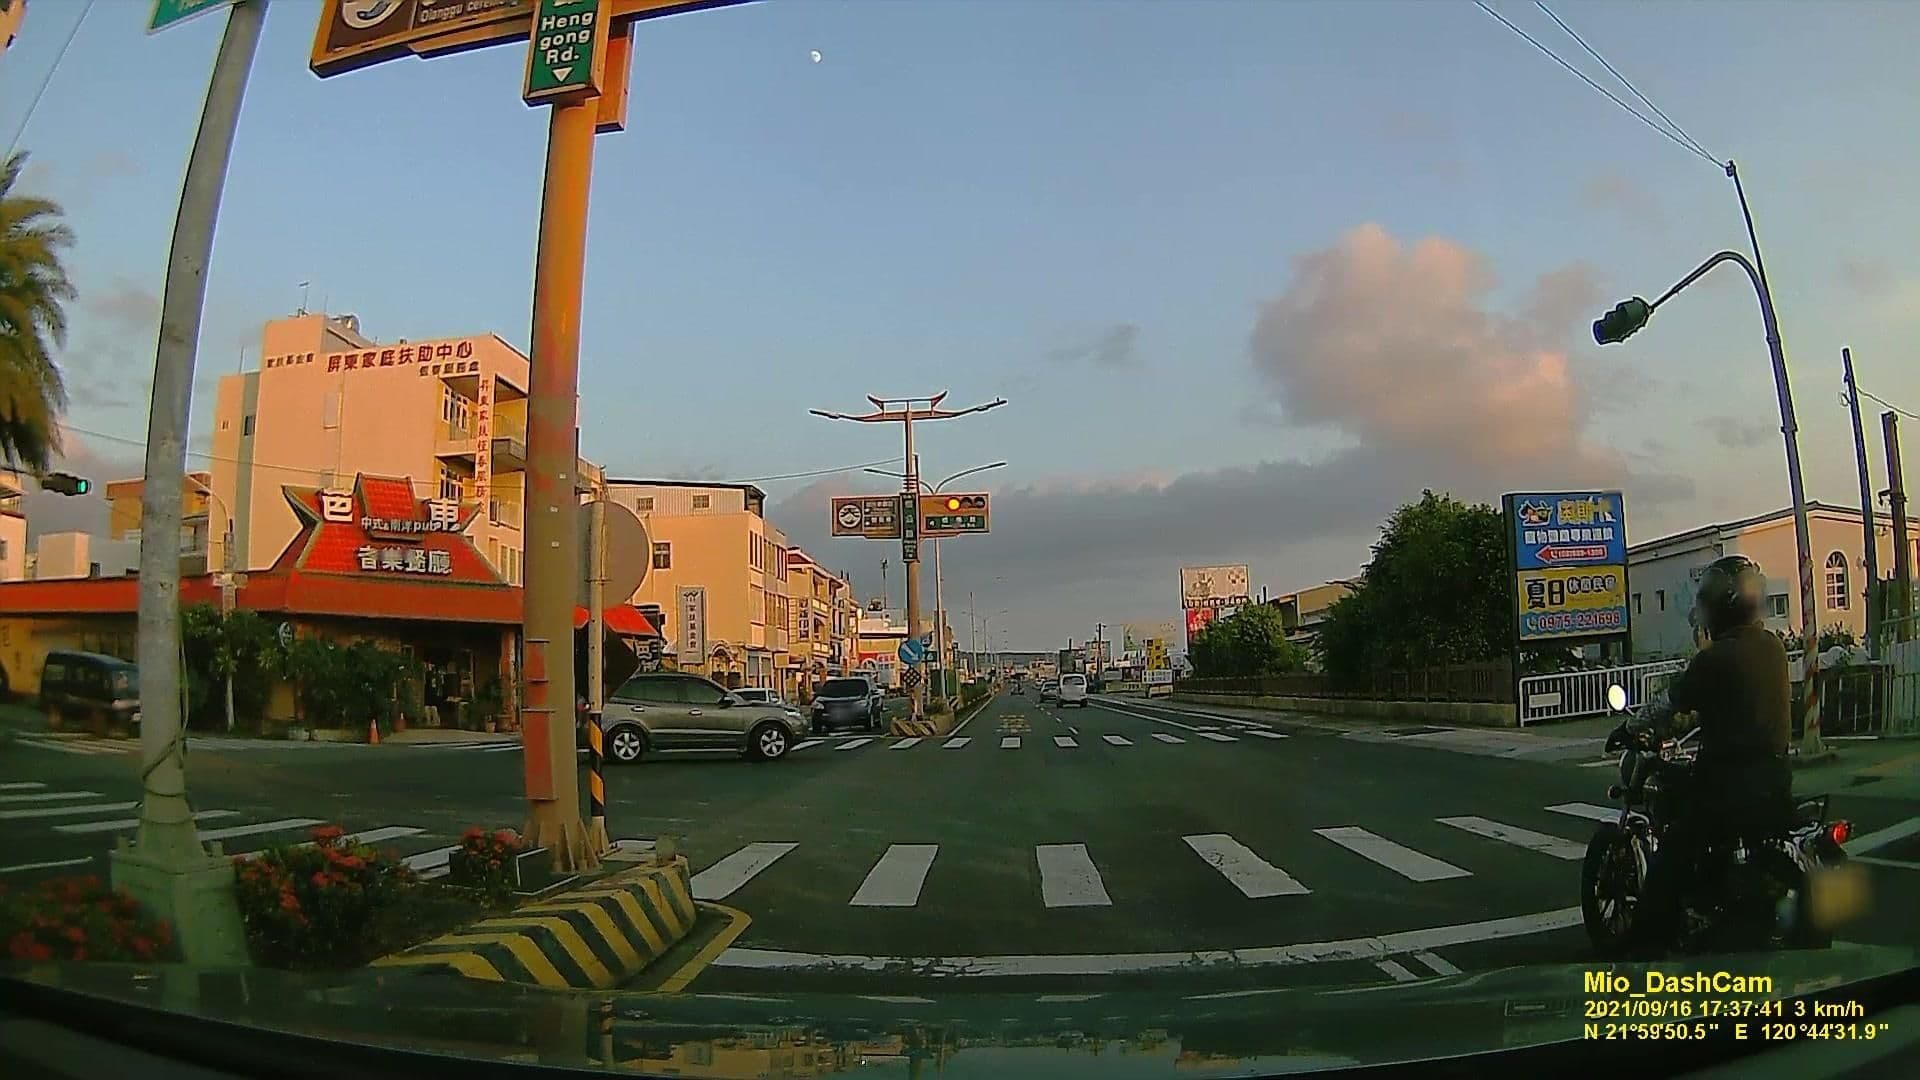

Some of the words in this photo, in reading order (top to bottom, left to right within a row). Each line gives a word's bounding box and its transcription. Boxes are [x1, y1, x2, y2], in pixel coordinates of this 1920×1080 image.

[541, 12, 594, 32] Heng
[539, 29, 591, 51] gong
[545, 46, 580, 65] Rd.
[327, 341, 473, 373] 屏東家庭扶助中心
[1524, 577, 1565, 610] 夏日
